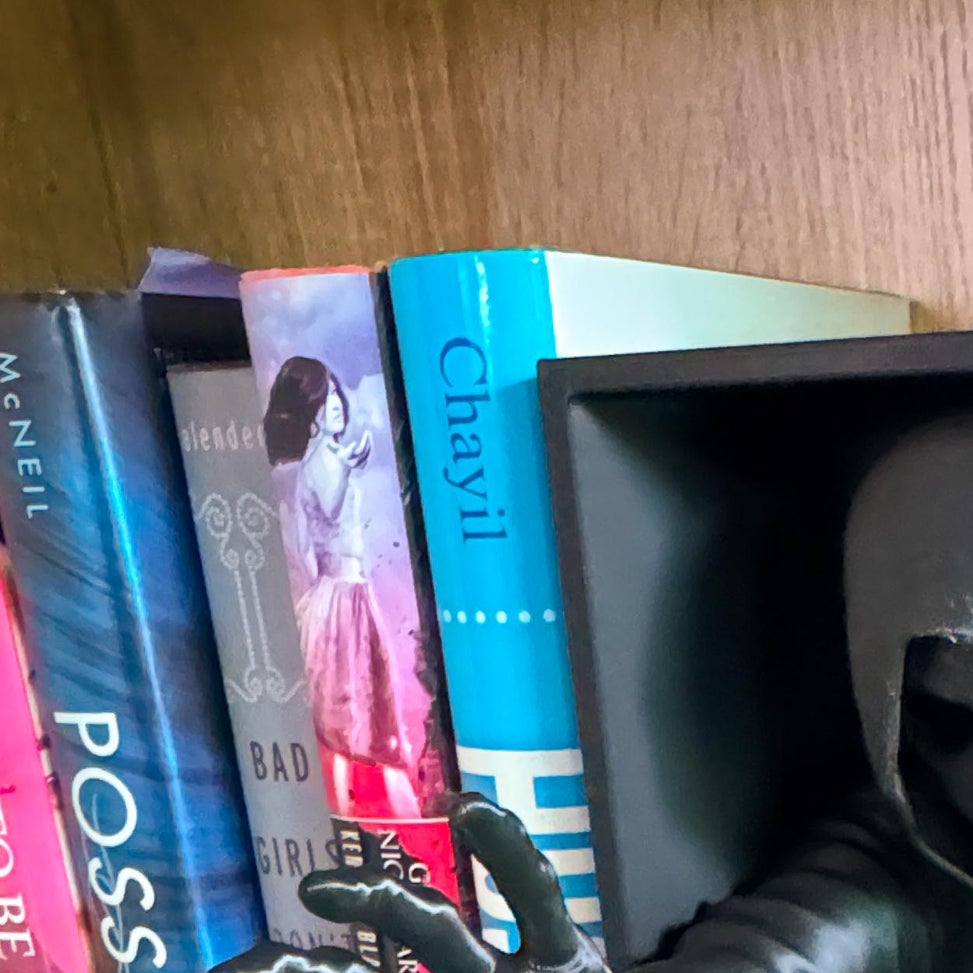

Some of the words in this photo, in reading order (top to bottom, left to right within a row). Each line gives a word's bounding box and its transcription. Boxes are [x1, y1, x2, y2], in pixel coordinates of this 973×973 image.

[0, 353, 49, 519] McNEIL
[439, 336, 509, 545] Chayil
[249, 740, 310, 783] BAD
